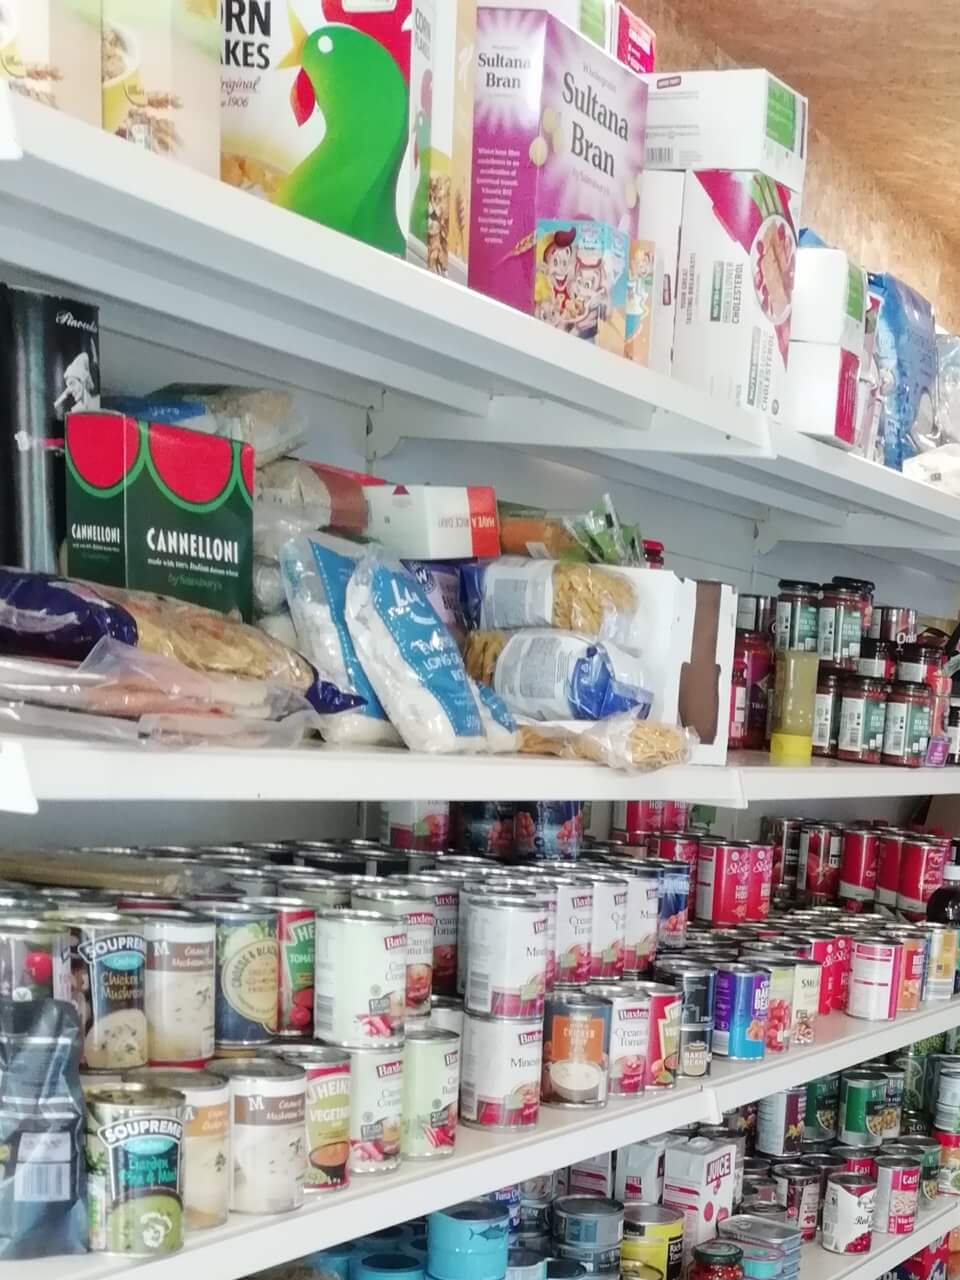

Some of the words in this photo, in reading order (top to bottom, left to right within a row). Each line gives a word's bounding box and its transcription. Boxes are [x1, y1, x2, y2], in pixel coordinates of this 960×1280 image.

[221, 0, 271, 37] RN
[220, 38, 270, 70] KES
[478, 53, 530, 70] Sultana
[221, 75, 261, 96] riginal
[486, 73, 521, 89] Bran
[562, 72, 630, 142] Sultana
[571, 121, 615, 178] Bran
[731, 262, 744, 324] CHOLESTEROL
[761, 335, 774, 411] CHOLESTEROL
[71, 523, 120, 544] CANNELLONI
[146, 528, 239, 564] CANNELLONI
[105, 1120, 182, 1142] SOUPREME
[708, 1153, 731, 1183] JUICE
